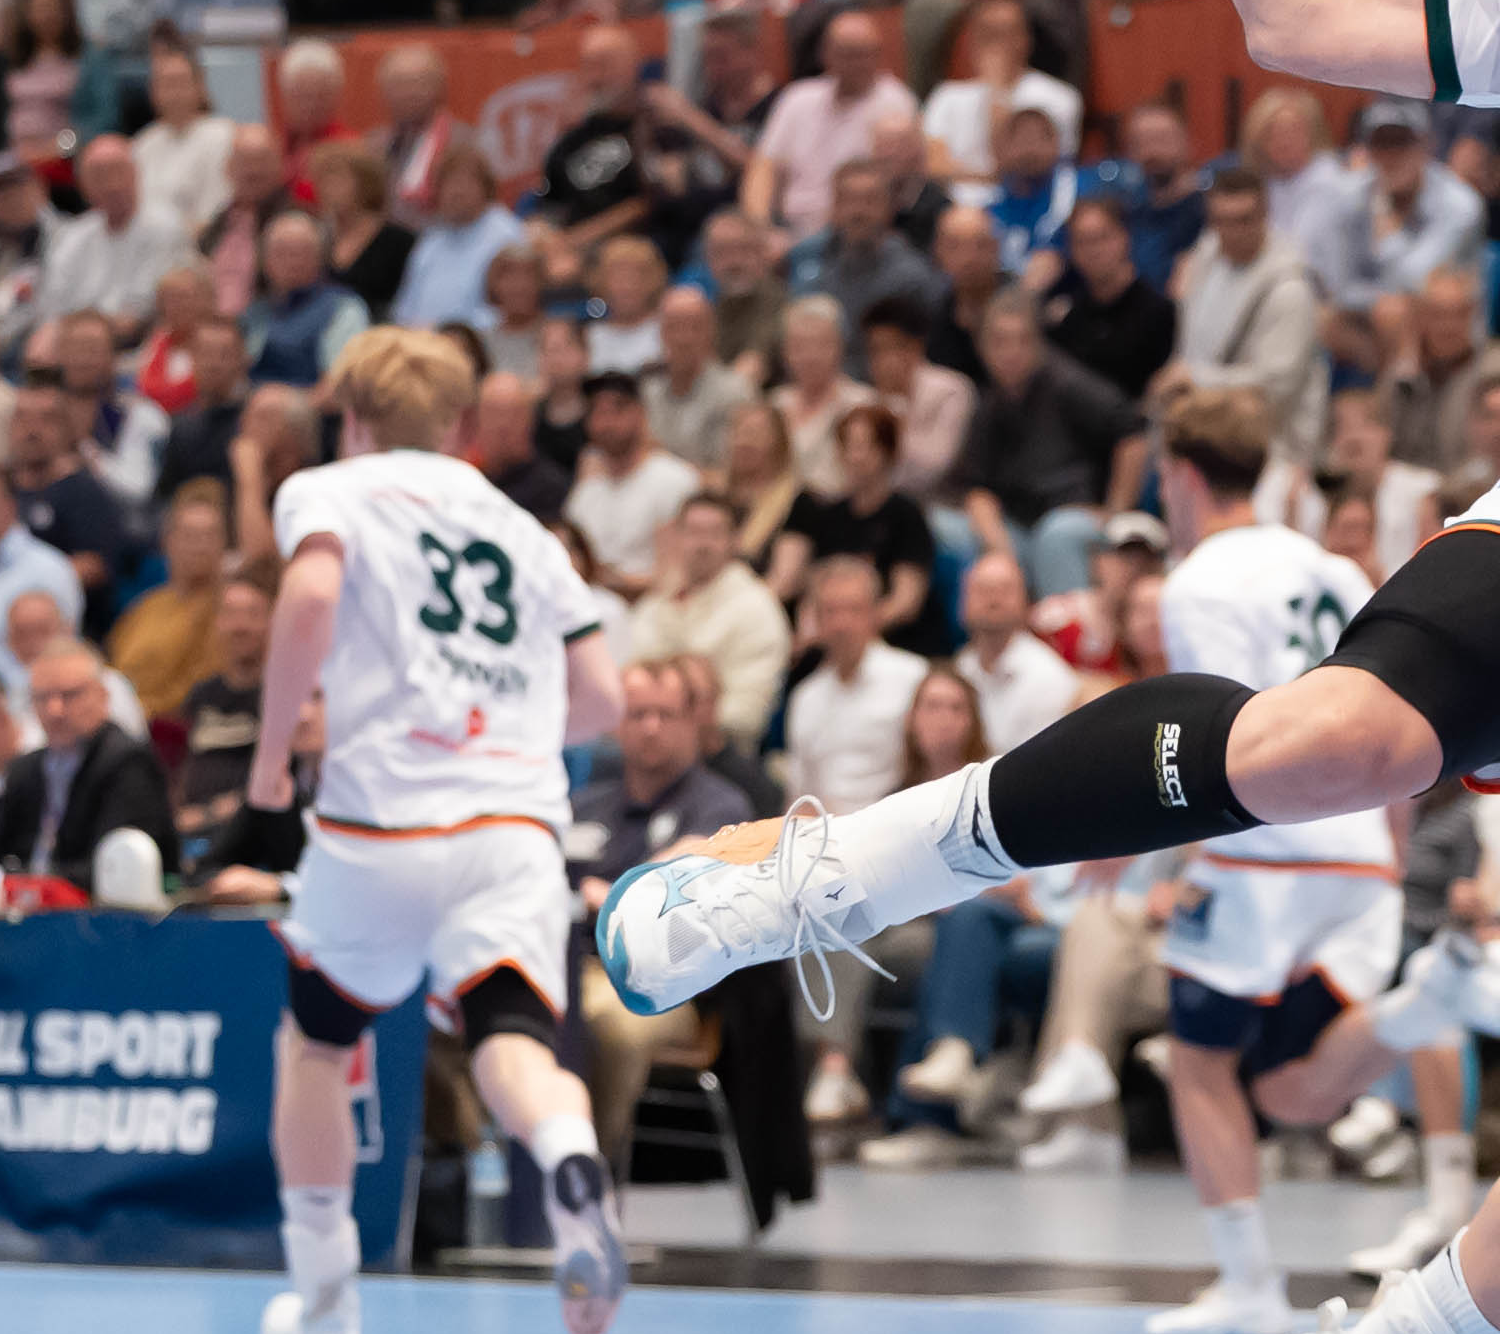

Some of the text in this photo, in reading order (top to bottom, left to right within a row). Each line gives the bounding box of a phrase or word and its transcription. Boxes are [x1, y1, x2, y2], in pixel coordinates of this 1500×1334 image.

[418, 531, 518, 646] 33
[1162, 723, 1188, 807] SELECT
[32, 1009, 222, 1078] SPORT
